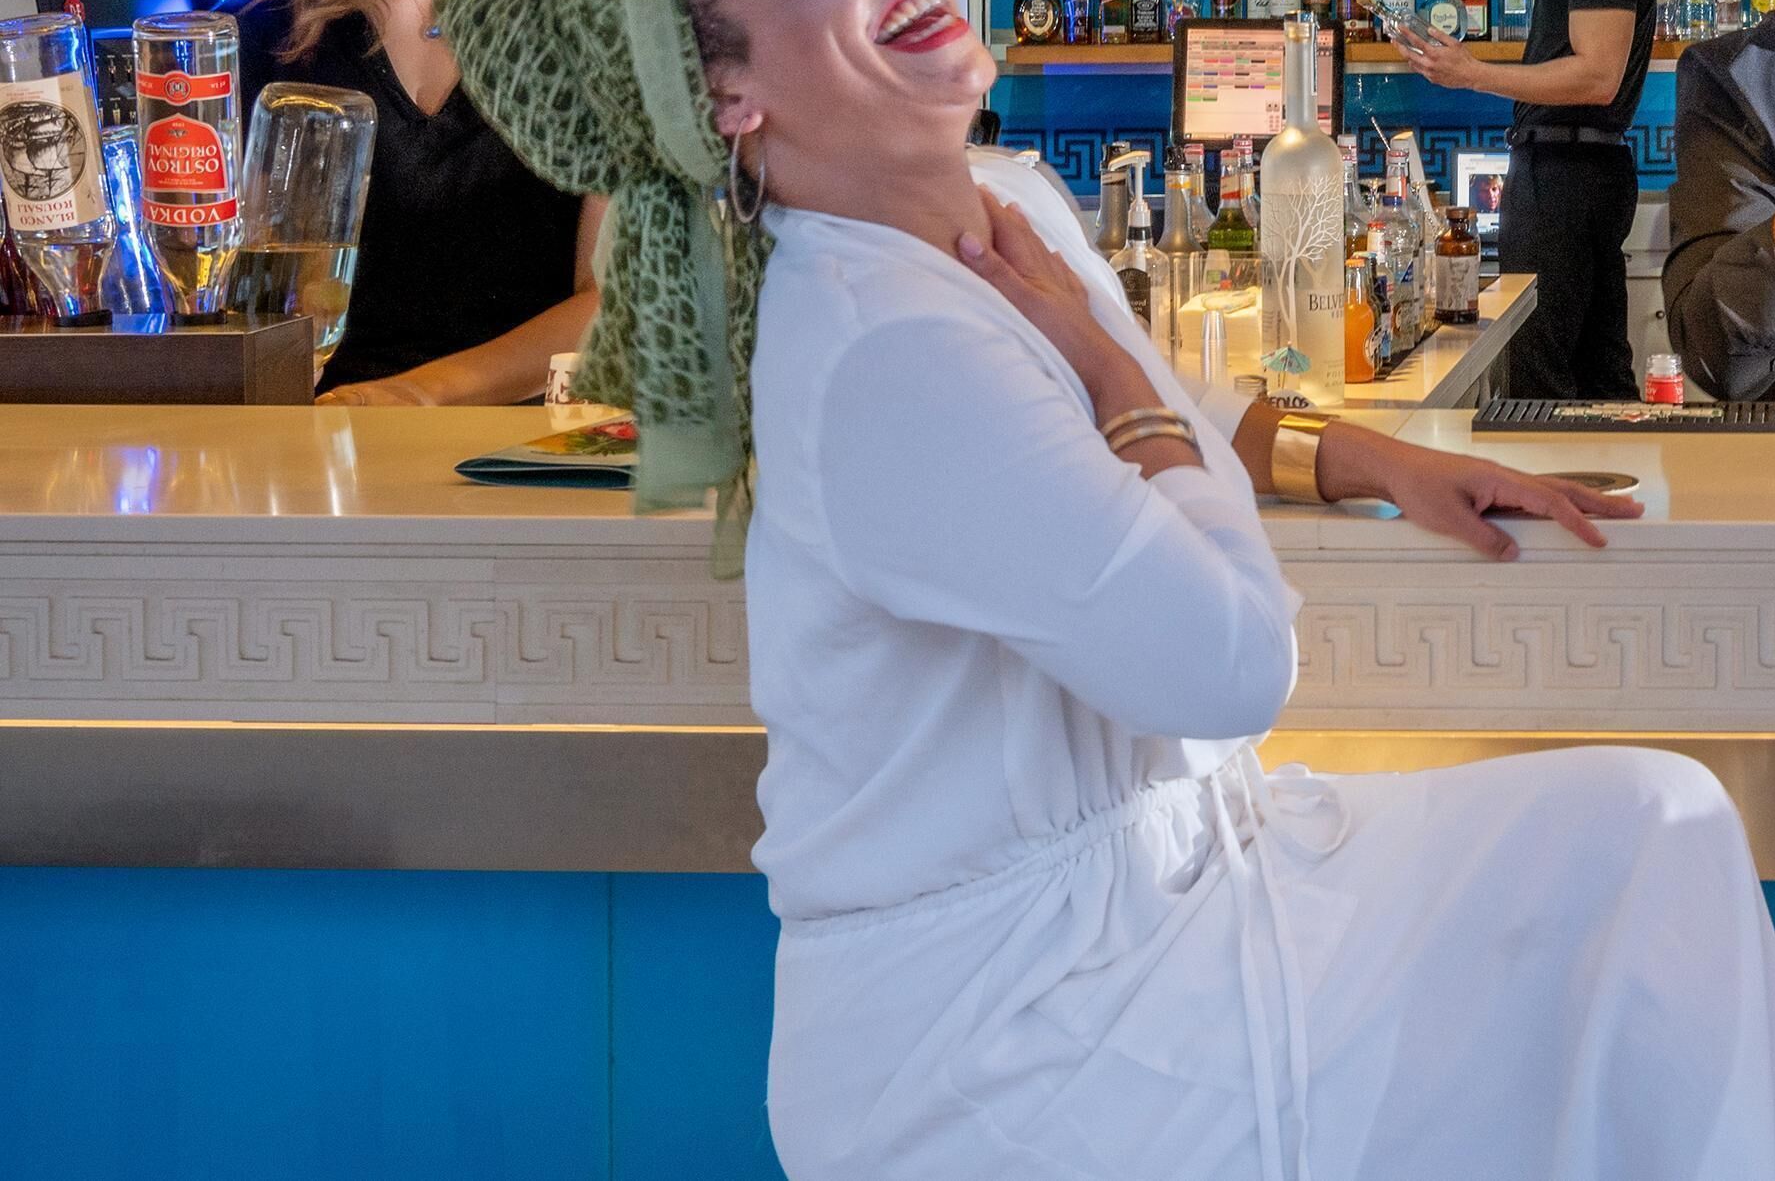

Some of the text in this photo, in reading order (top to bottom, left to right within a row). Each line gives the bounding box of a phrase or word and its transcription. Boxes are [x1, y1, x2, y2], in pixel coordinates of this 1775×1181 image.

[148, 143, 217, 158] ORIGINAL
[147, 158, 220, 174] OSTROV
[17, 201, 73, 214] ROUSALI
[150, 205, 221, 224] VODKA
[20, 211, 75, 227] BLANCO
